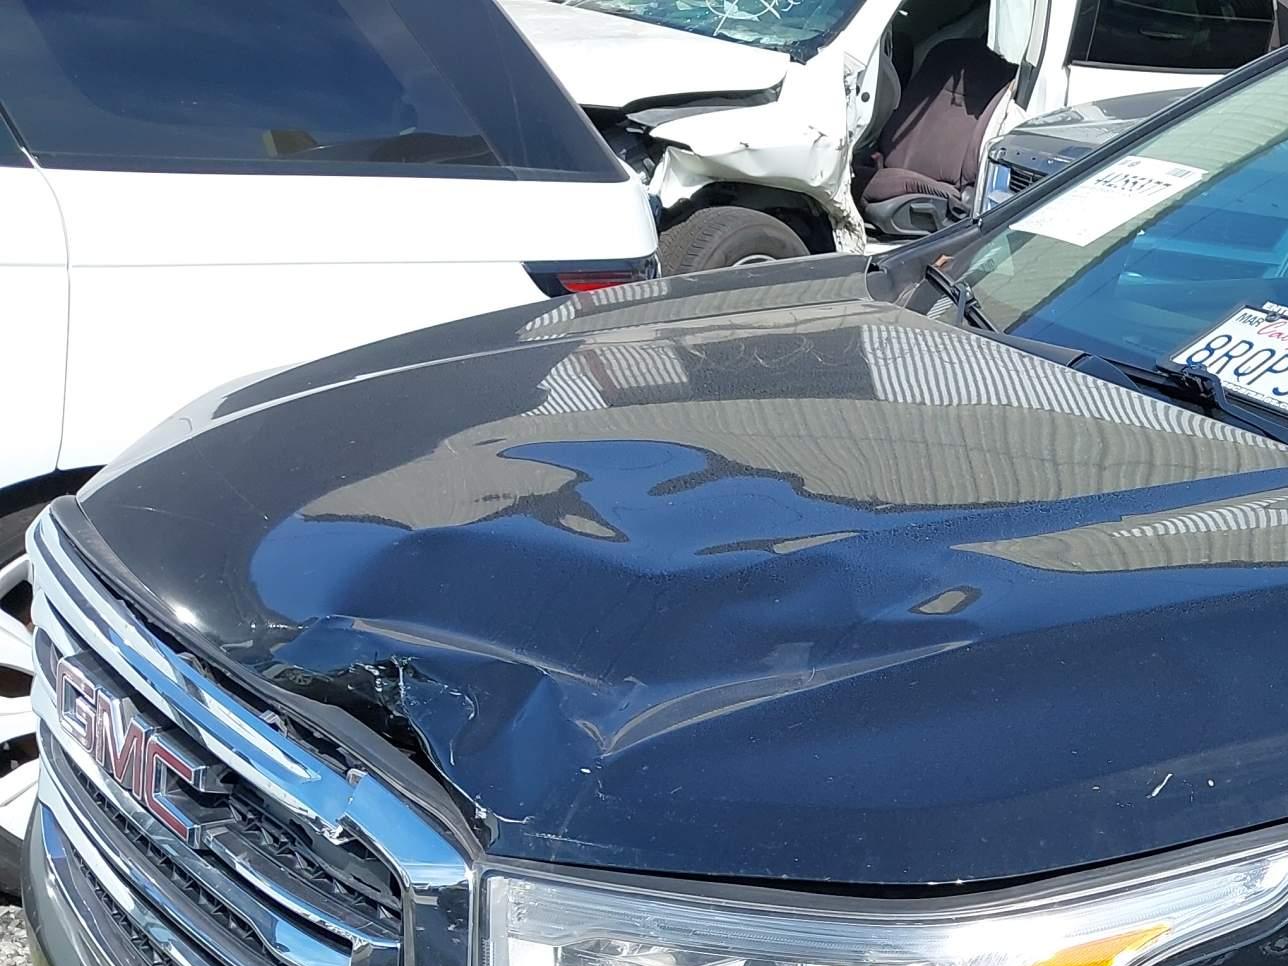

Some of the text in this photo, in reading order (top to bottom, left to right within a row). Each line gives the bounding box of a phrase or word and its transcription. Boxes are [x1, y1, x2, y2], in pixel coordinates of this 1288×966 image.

[1094, 171, 1173, 197] 44255377
[1235, 311, 1266, 328] MAR
[56, 657, 206, 849] GMC
